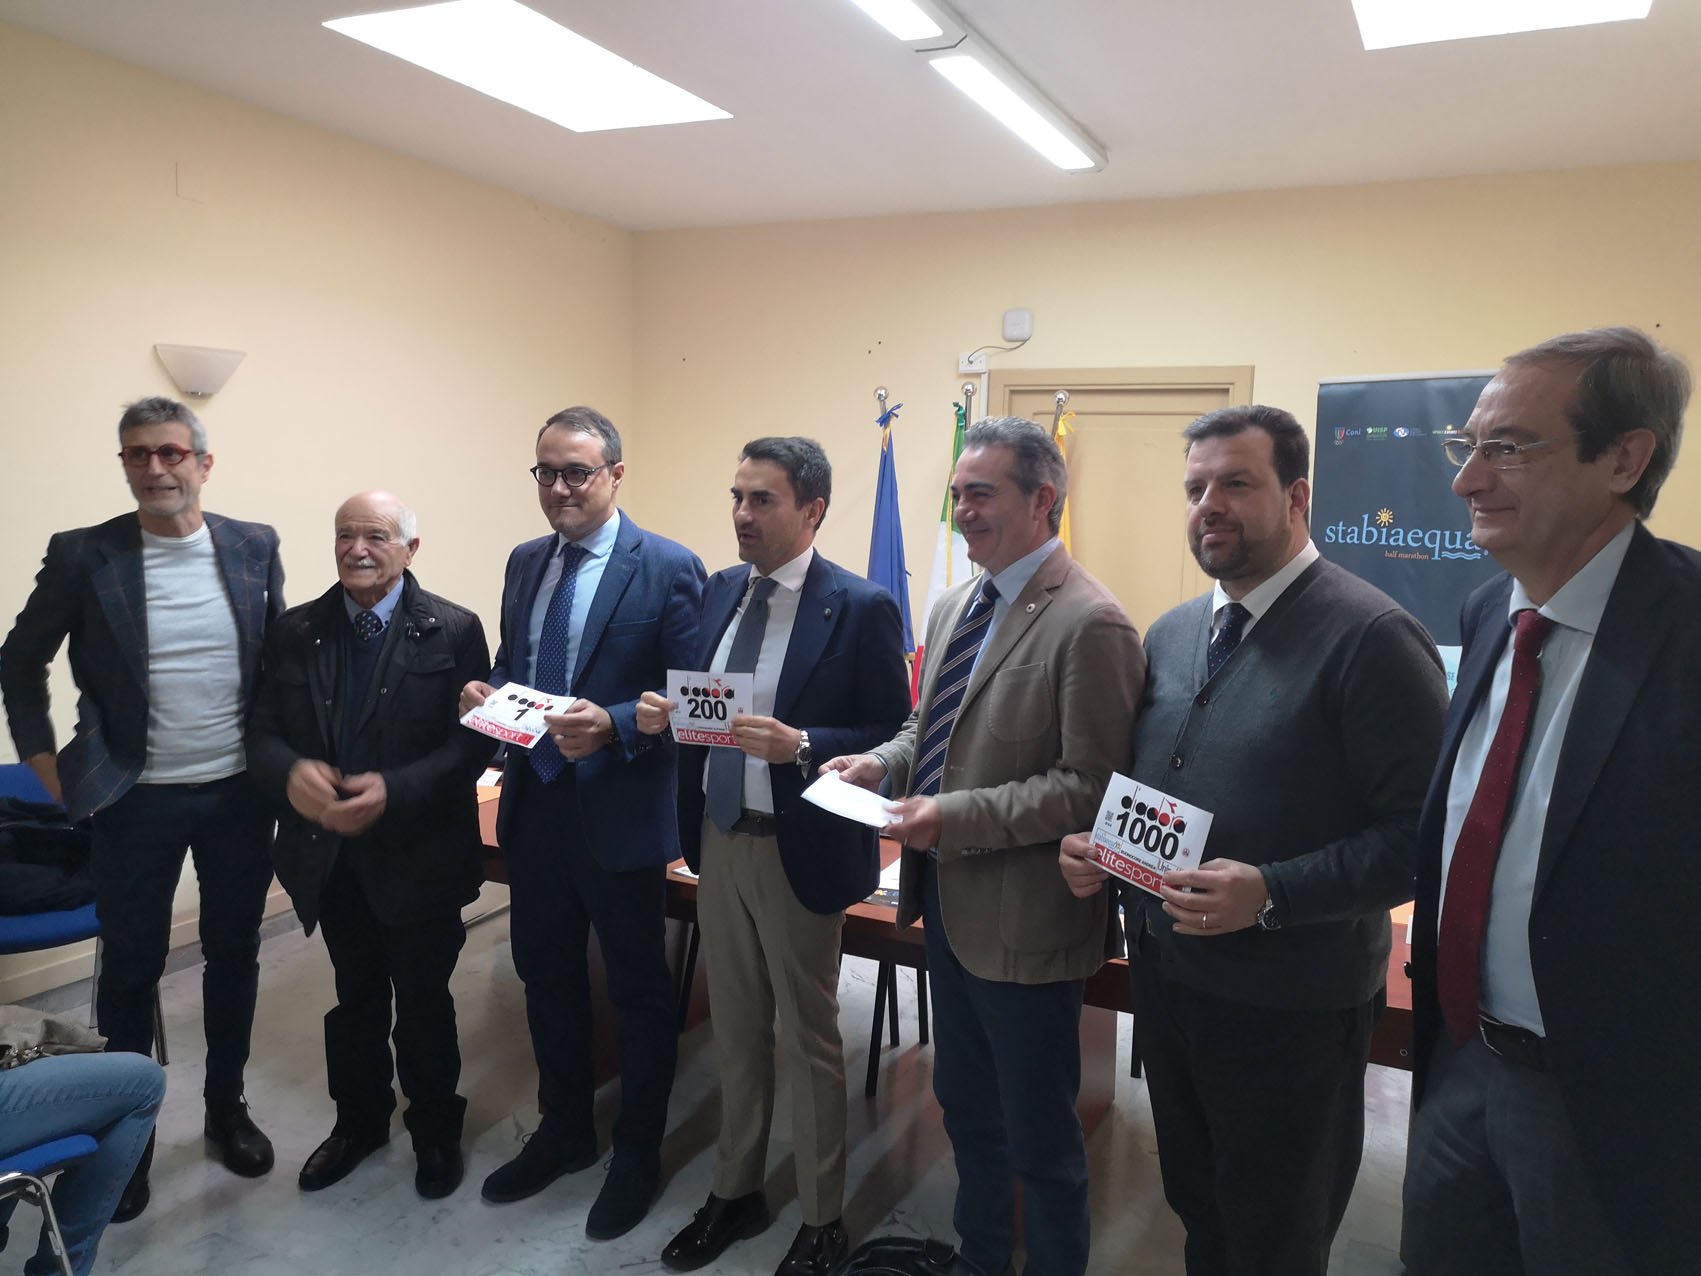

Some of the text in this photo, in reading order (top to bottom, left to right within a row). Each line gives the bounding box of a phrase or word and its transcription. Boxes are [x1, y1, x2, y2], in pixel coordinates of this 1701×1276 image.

[1346, 428, 1361, 436] Coni
[1385, 550, 1429, 560] half marathon
[514, 708, 529, 721] 1
[687, 698, 727, 721] 200
[1116, 811, 1179, 861] 1000
